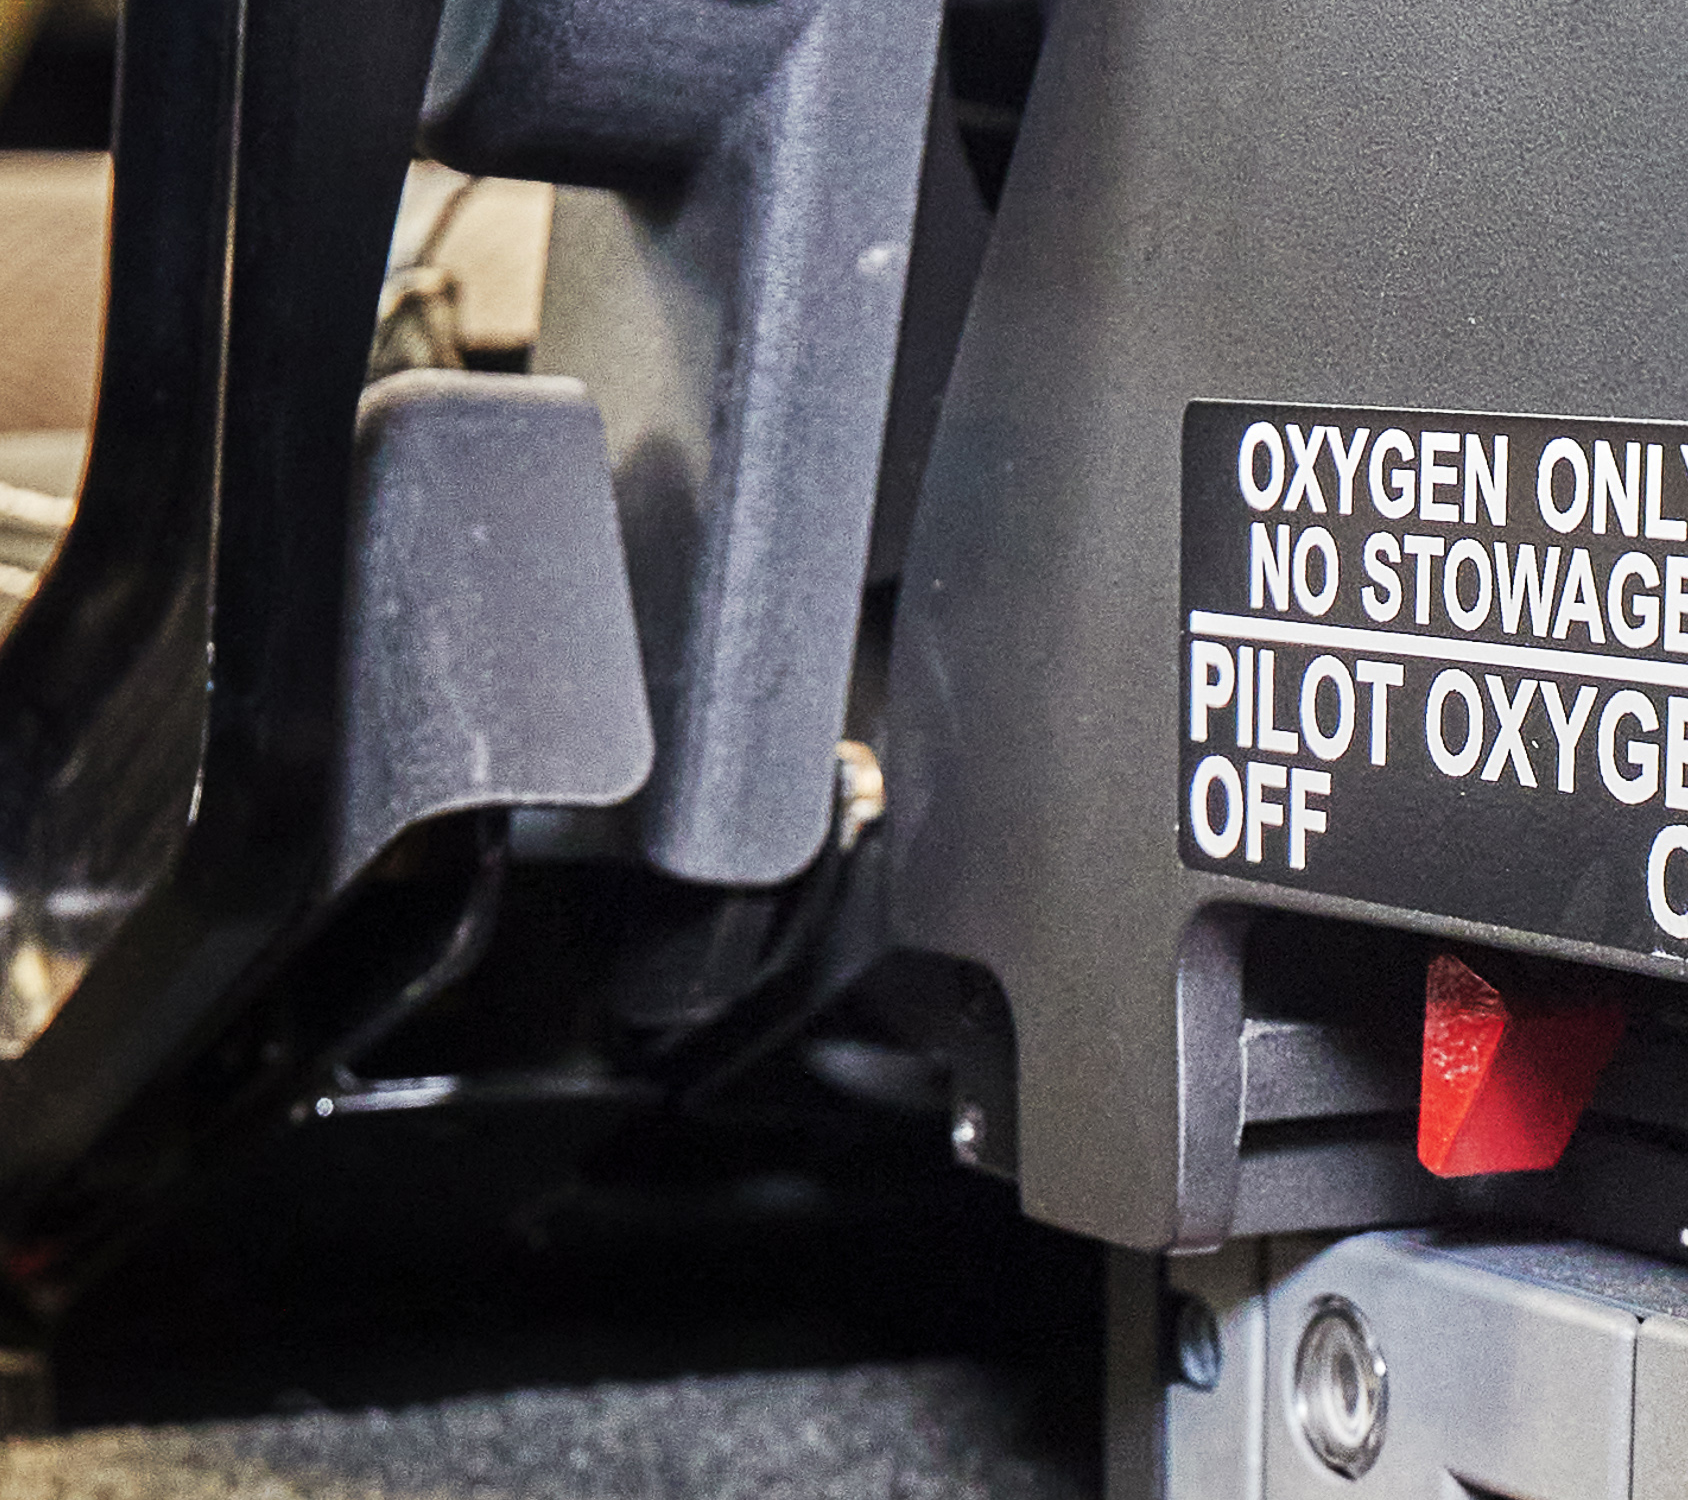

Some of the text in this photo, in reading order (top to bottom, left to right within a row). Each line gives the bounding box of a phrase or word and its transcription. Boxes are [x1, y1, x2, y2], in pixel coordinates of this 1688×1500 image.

[1238, 420, 1509, 527] OXYGEN
[1249, 521, 1340, 617] NO
[1190, 639, 1405, 767] PILOT
[1190, 754, 1332, 870] OFF
